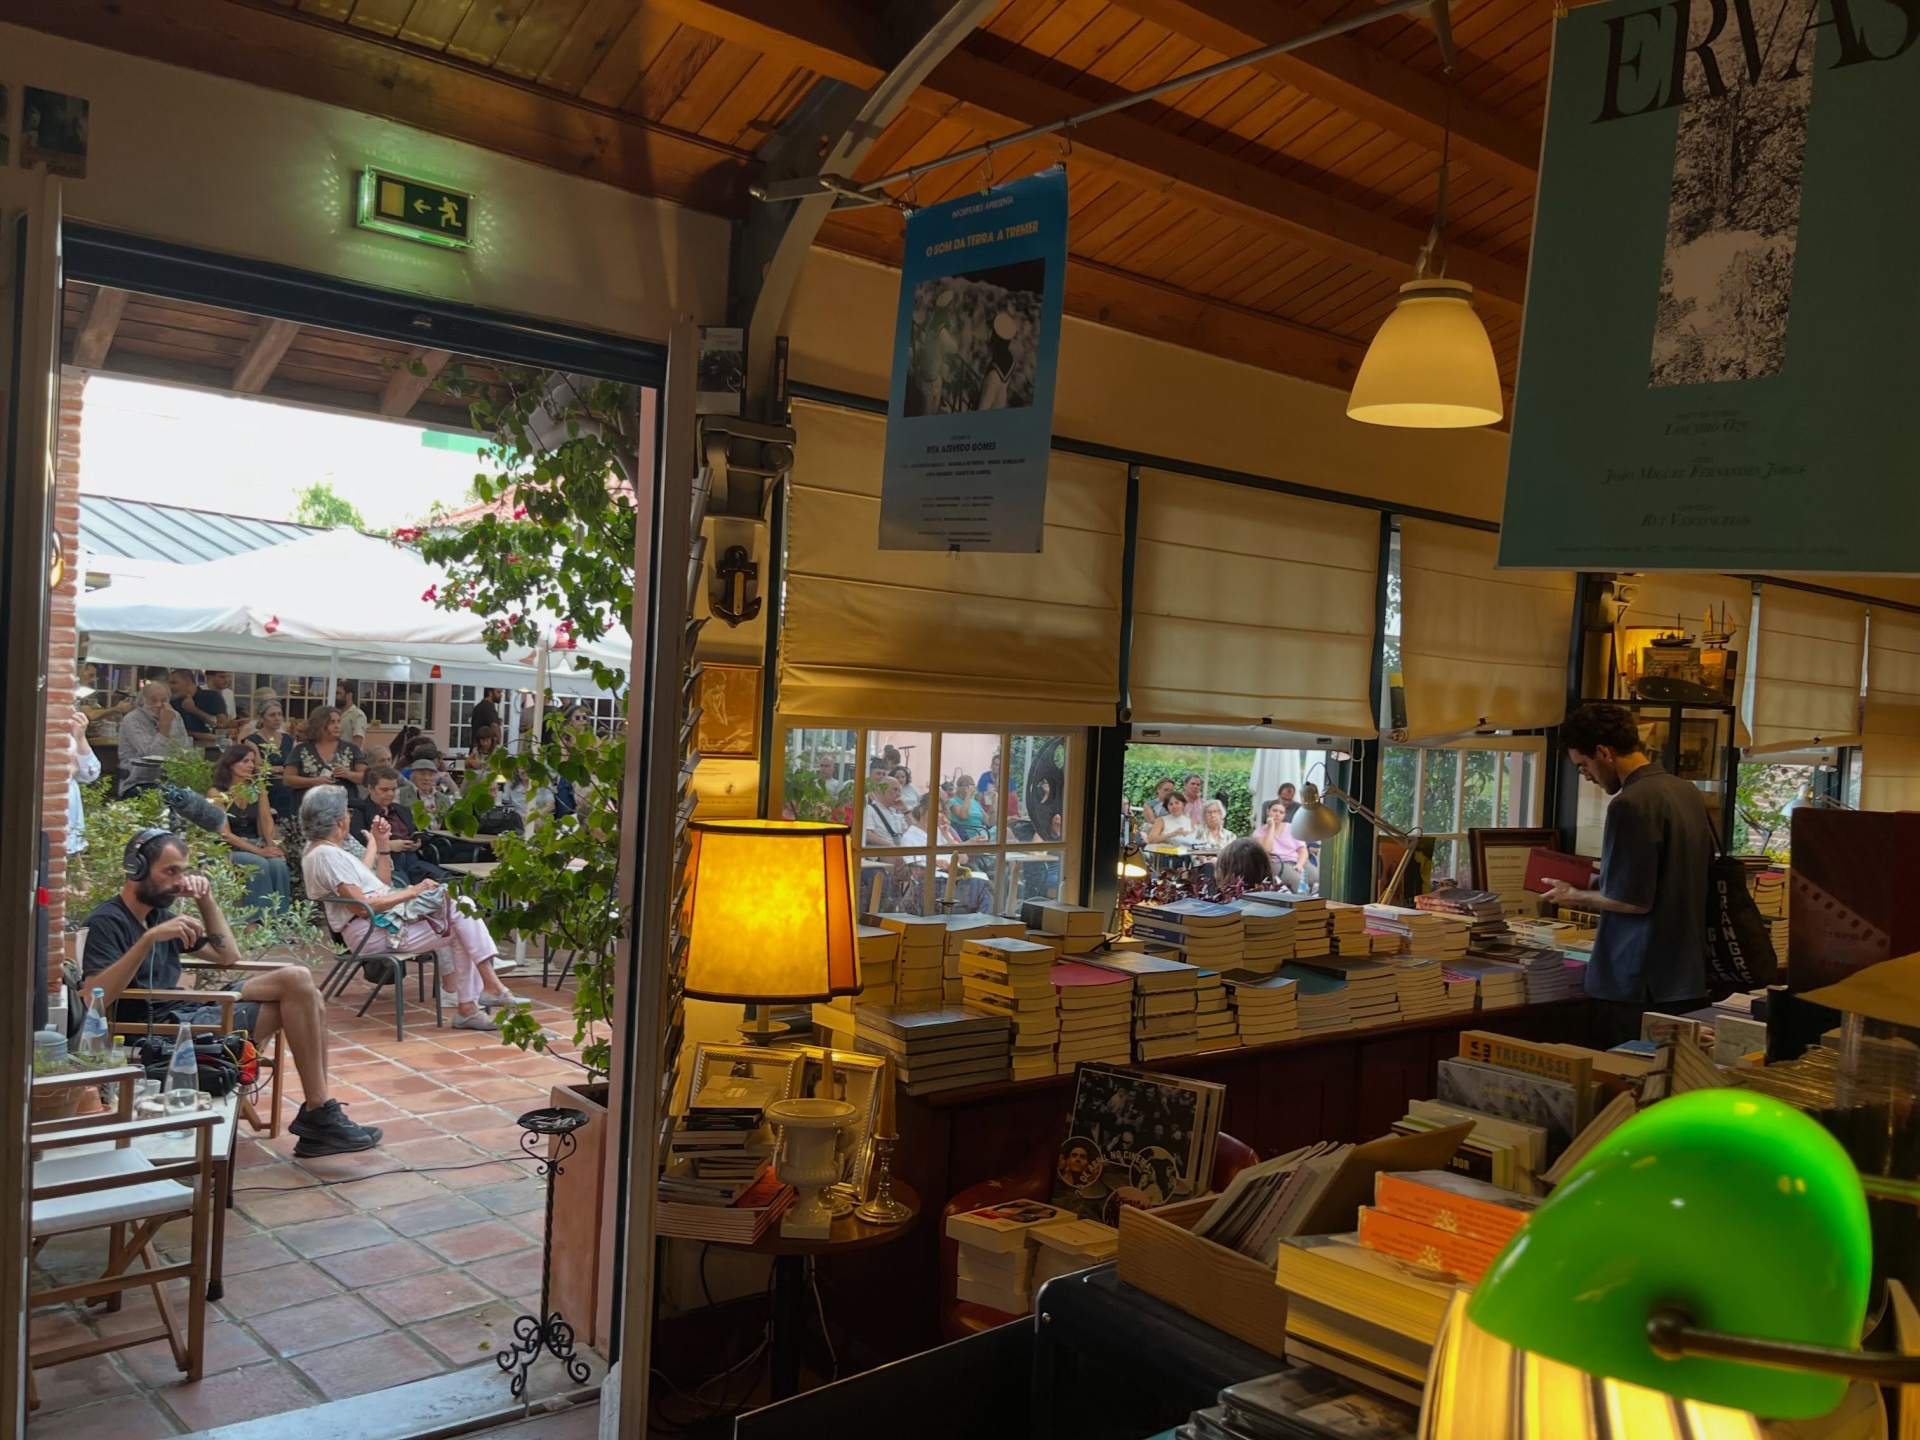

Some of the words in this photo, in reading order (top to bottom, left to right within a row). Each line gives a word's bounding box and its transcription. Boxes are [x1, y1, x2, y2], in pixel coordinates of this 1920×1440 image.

[926, 246, 933, 258] O
[934, 241, 953, 255] SOM
[953, 237, 967, 251] DA
[967, 232, 995, 247] TERRA
[996, 229, 1005, 242] A
[1005, 220, 1039, 238] TREMER
[925, 445, 940, 454] RITA
[941, 443, 971, 453] AZEVEDO
[971, 441, 997, 452] GOMES
[1495, 1046, 1571, 1075] TRESPASSE
[1079, 1170, 1091, 1183] DE
[1088, 1154, 1108, 1172] ABRIL
[1109, 1150, 1122, 1160] NO
[1123, 1150, 1152, 1172] CINEMA
